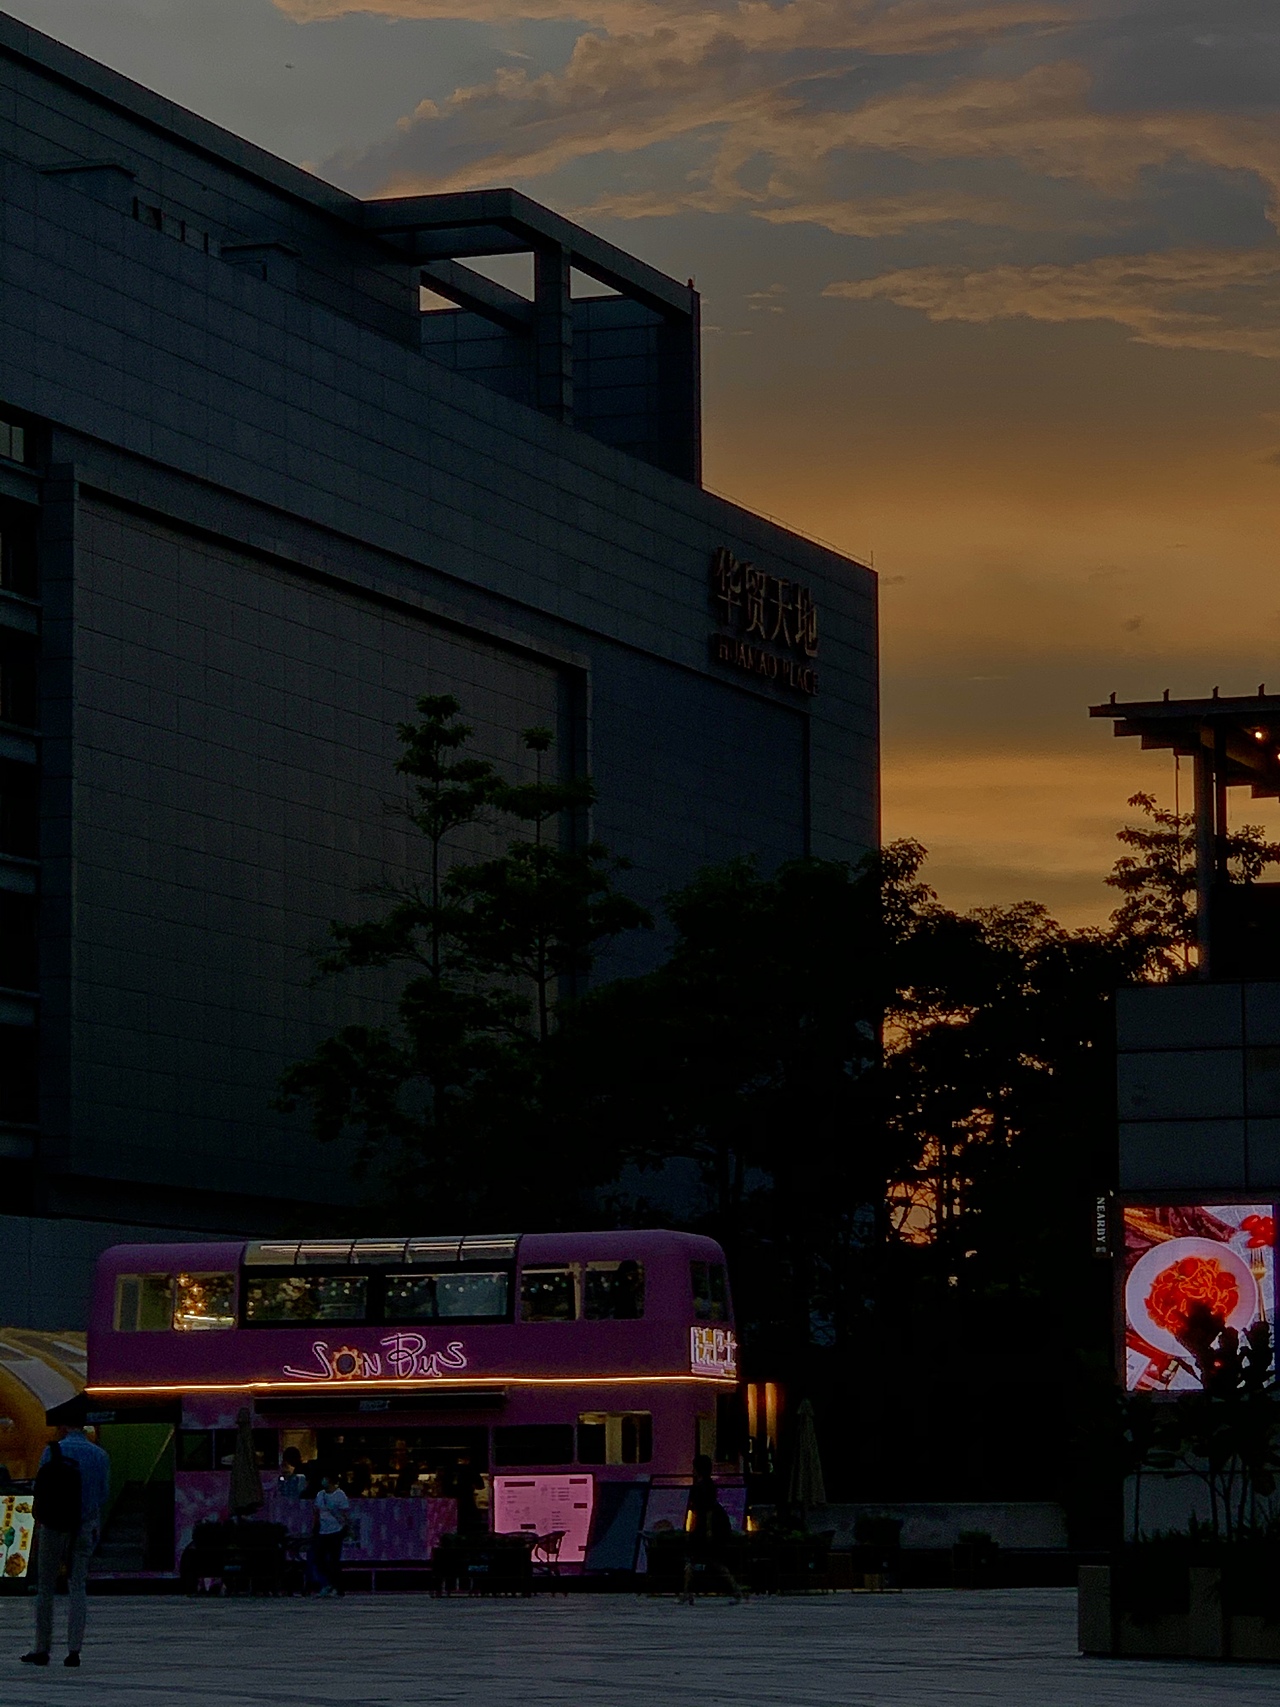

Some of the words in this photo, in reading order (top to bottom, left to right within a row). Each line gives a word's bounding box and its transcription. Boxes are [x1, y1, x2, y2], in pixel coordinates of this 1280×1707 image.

[712, 547, 819, 658] 华贸天地
[283, 1341, 382, 1379] SON
